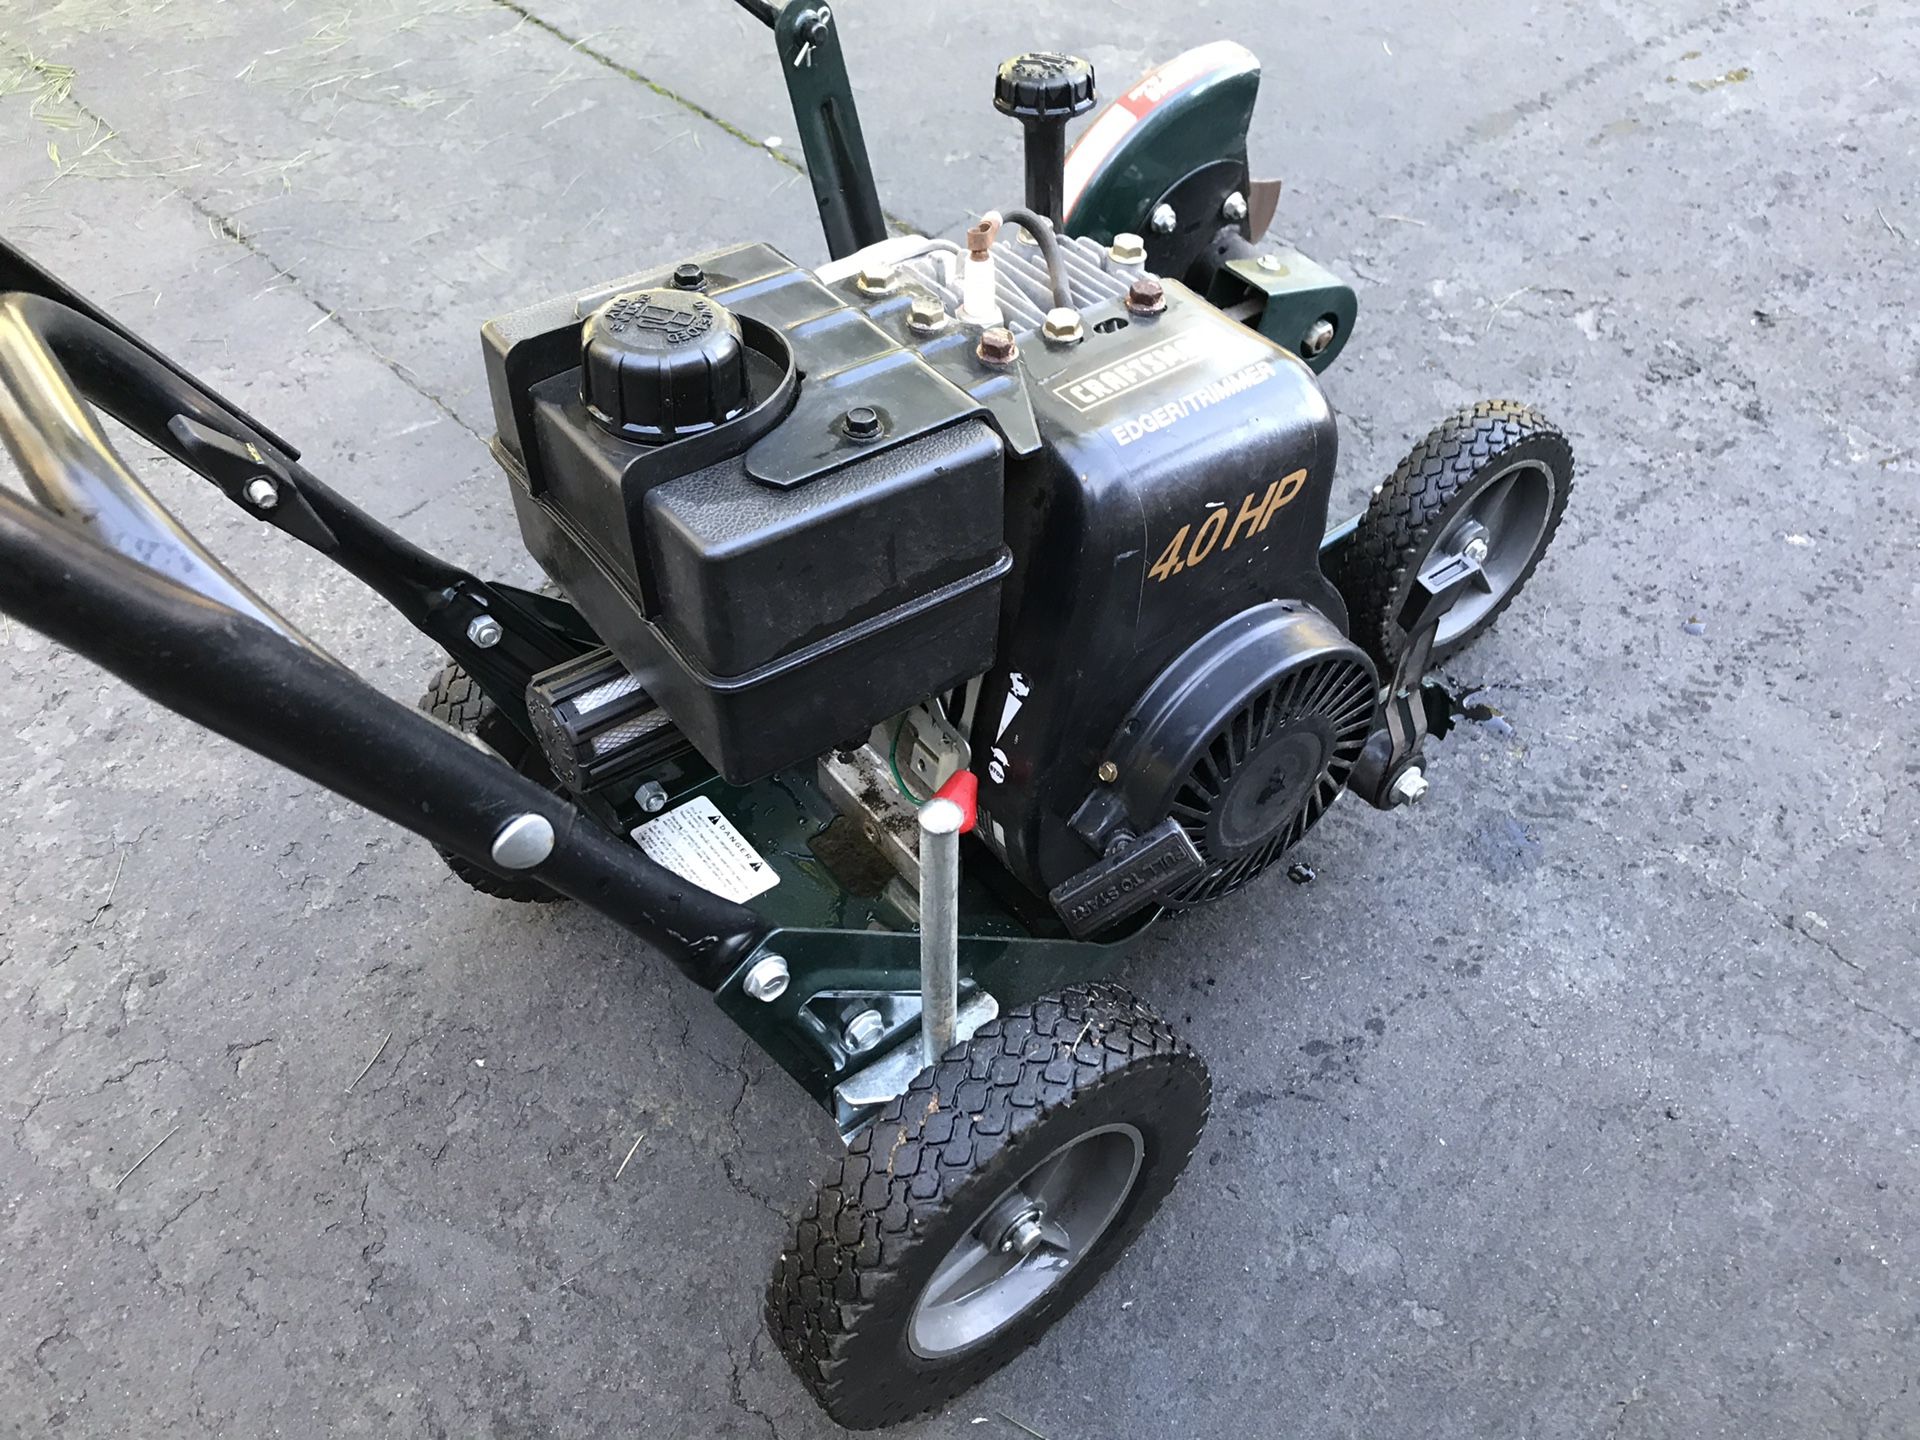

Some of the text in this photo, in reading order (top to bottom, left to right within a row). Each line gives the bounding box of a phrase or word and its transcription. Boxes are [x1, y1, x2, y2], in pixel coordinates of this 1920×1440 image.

[667, 301, 713, 343] UNLEADED
[1110, 361, 1277, 447] EDGER/TRIMMER
[1147, 468, 1308, 582] 4.0 HP
[990, 764, 1004, 779] STOP
[719, 825, 752, 859] DANGER
[1071, 845, 1187, 923] PULL TO START
